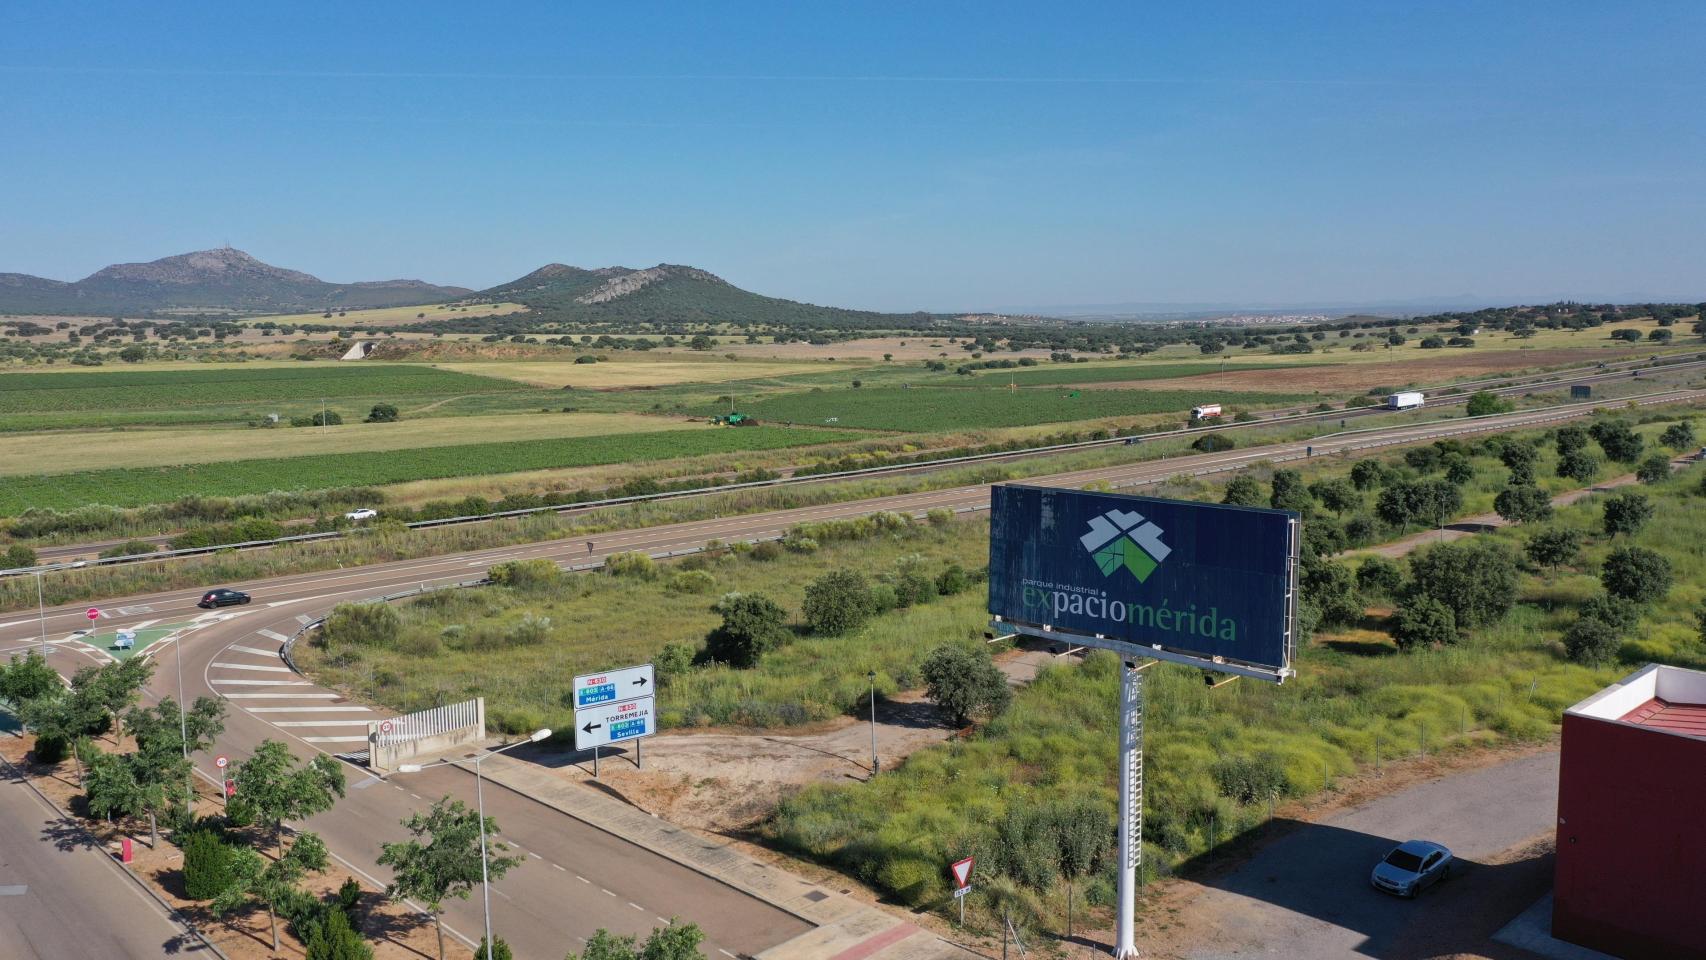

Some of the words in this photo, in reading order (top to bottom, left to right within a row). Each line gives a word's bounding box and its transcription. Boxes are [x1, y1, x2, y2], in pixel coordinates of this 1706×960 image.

[1022, 579, 1053, 589] parque
[1056, 582, 1099, 595] industrial
[1023, 586, 1236, 641] expaciomérida
[586, 695, 609, 703] Mérida
[617, 729, 639, 738] Sevilla
